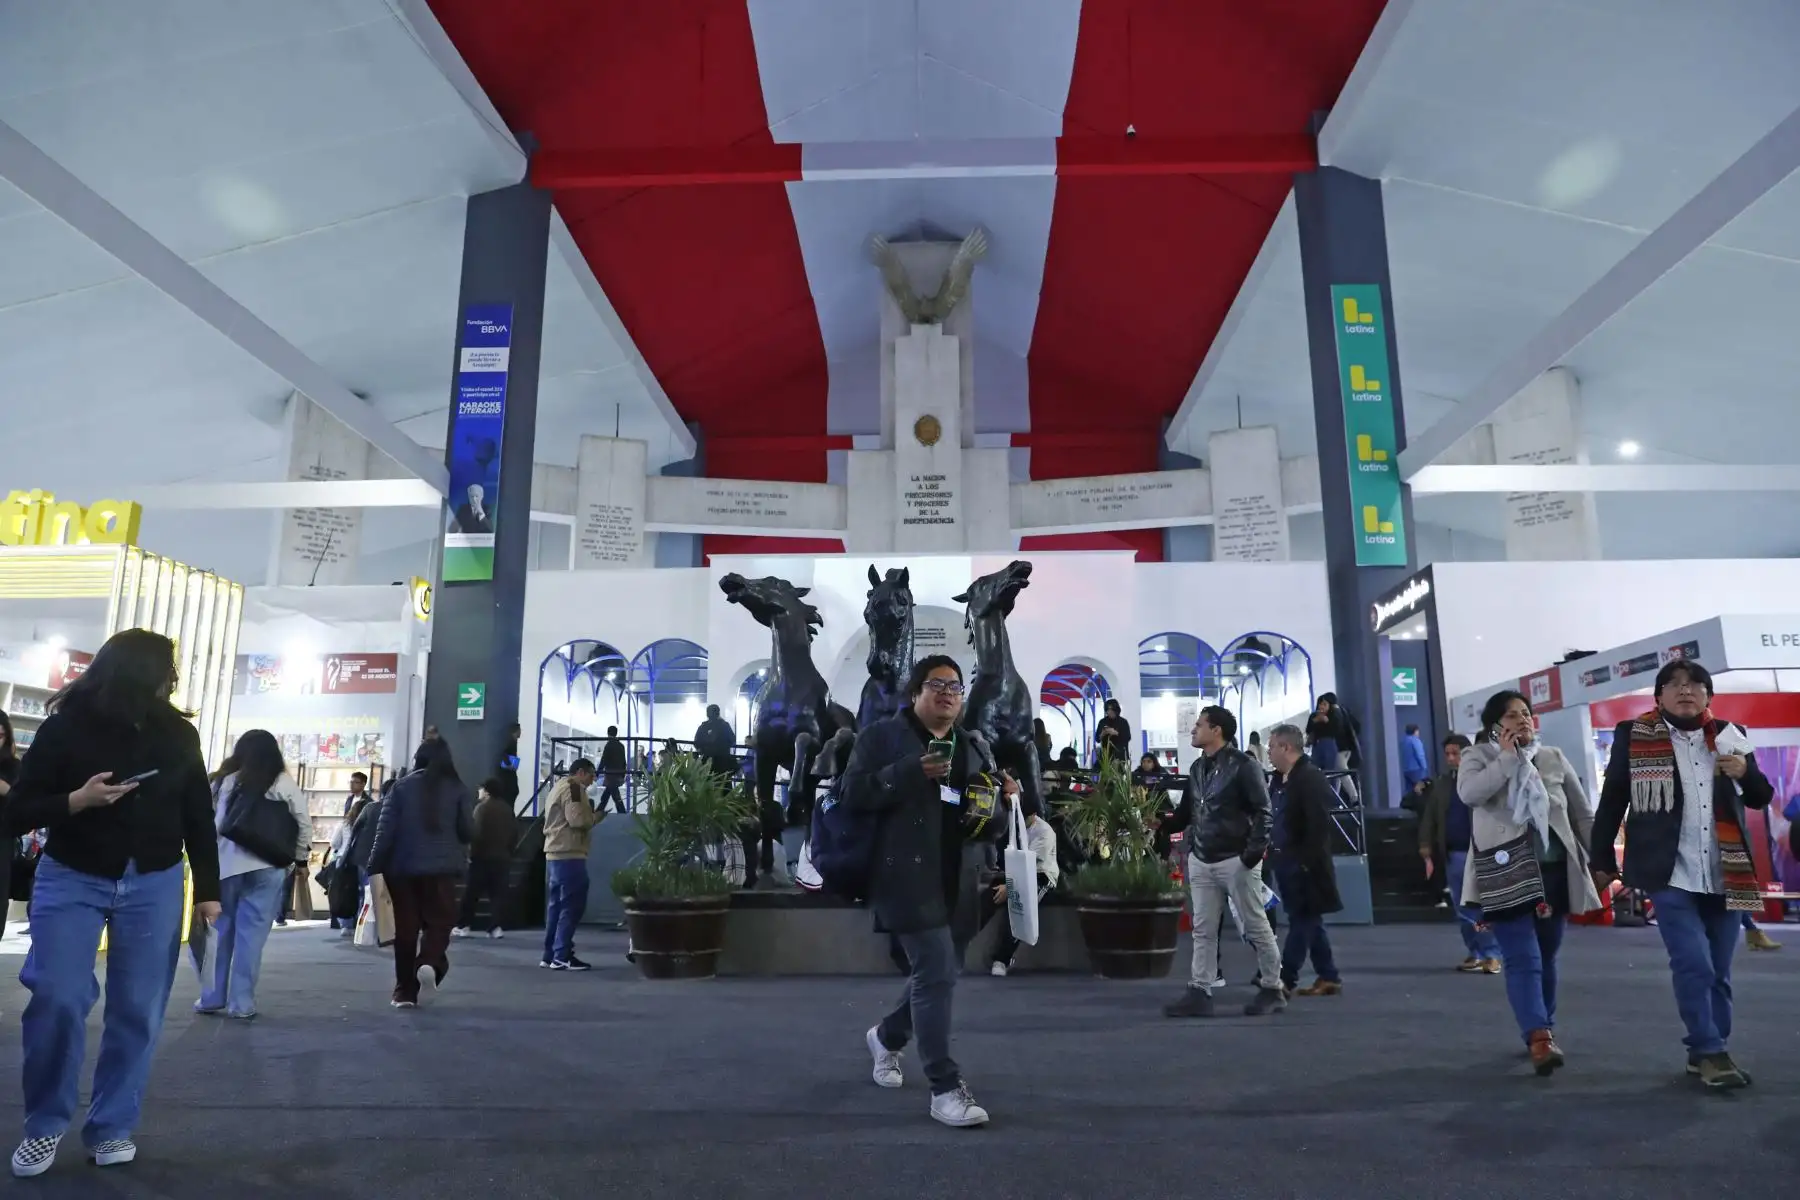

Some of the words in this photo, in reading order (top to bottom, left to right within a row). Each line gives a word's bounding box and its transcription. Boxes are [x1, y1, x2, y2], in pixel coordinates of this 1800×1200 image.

[481, 325, 508, 333] BBVA
[459, 401, 502, 409] KARAOKE
[1761, 634, 1778, 647] EL
[1781, 633, 1800, 647] PE
